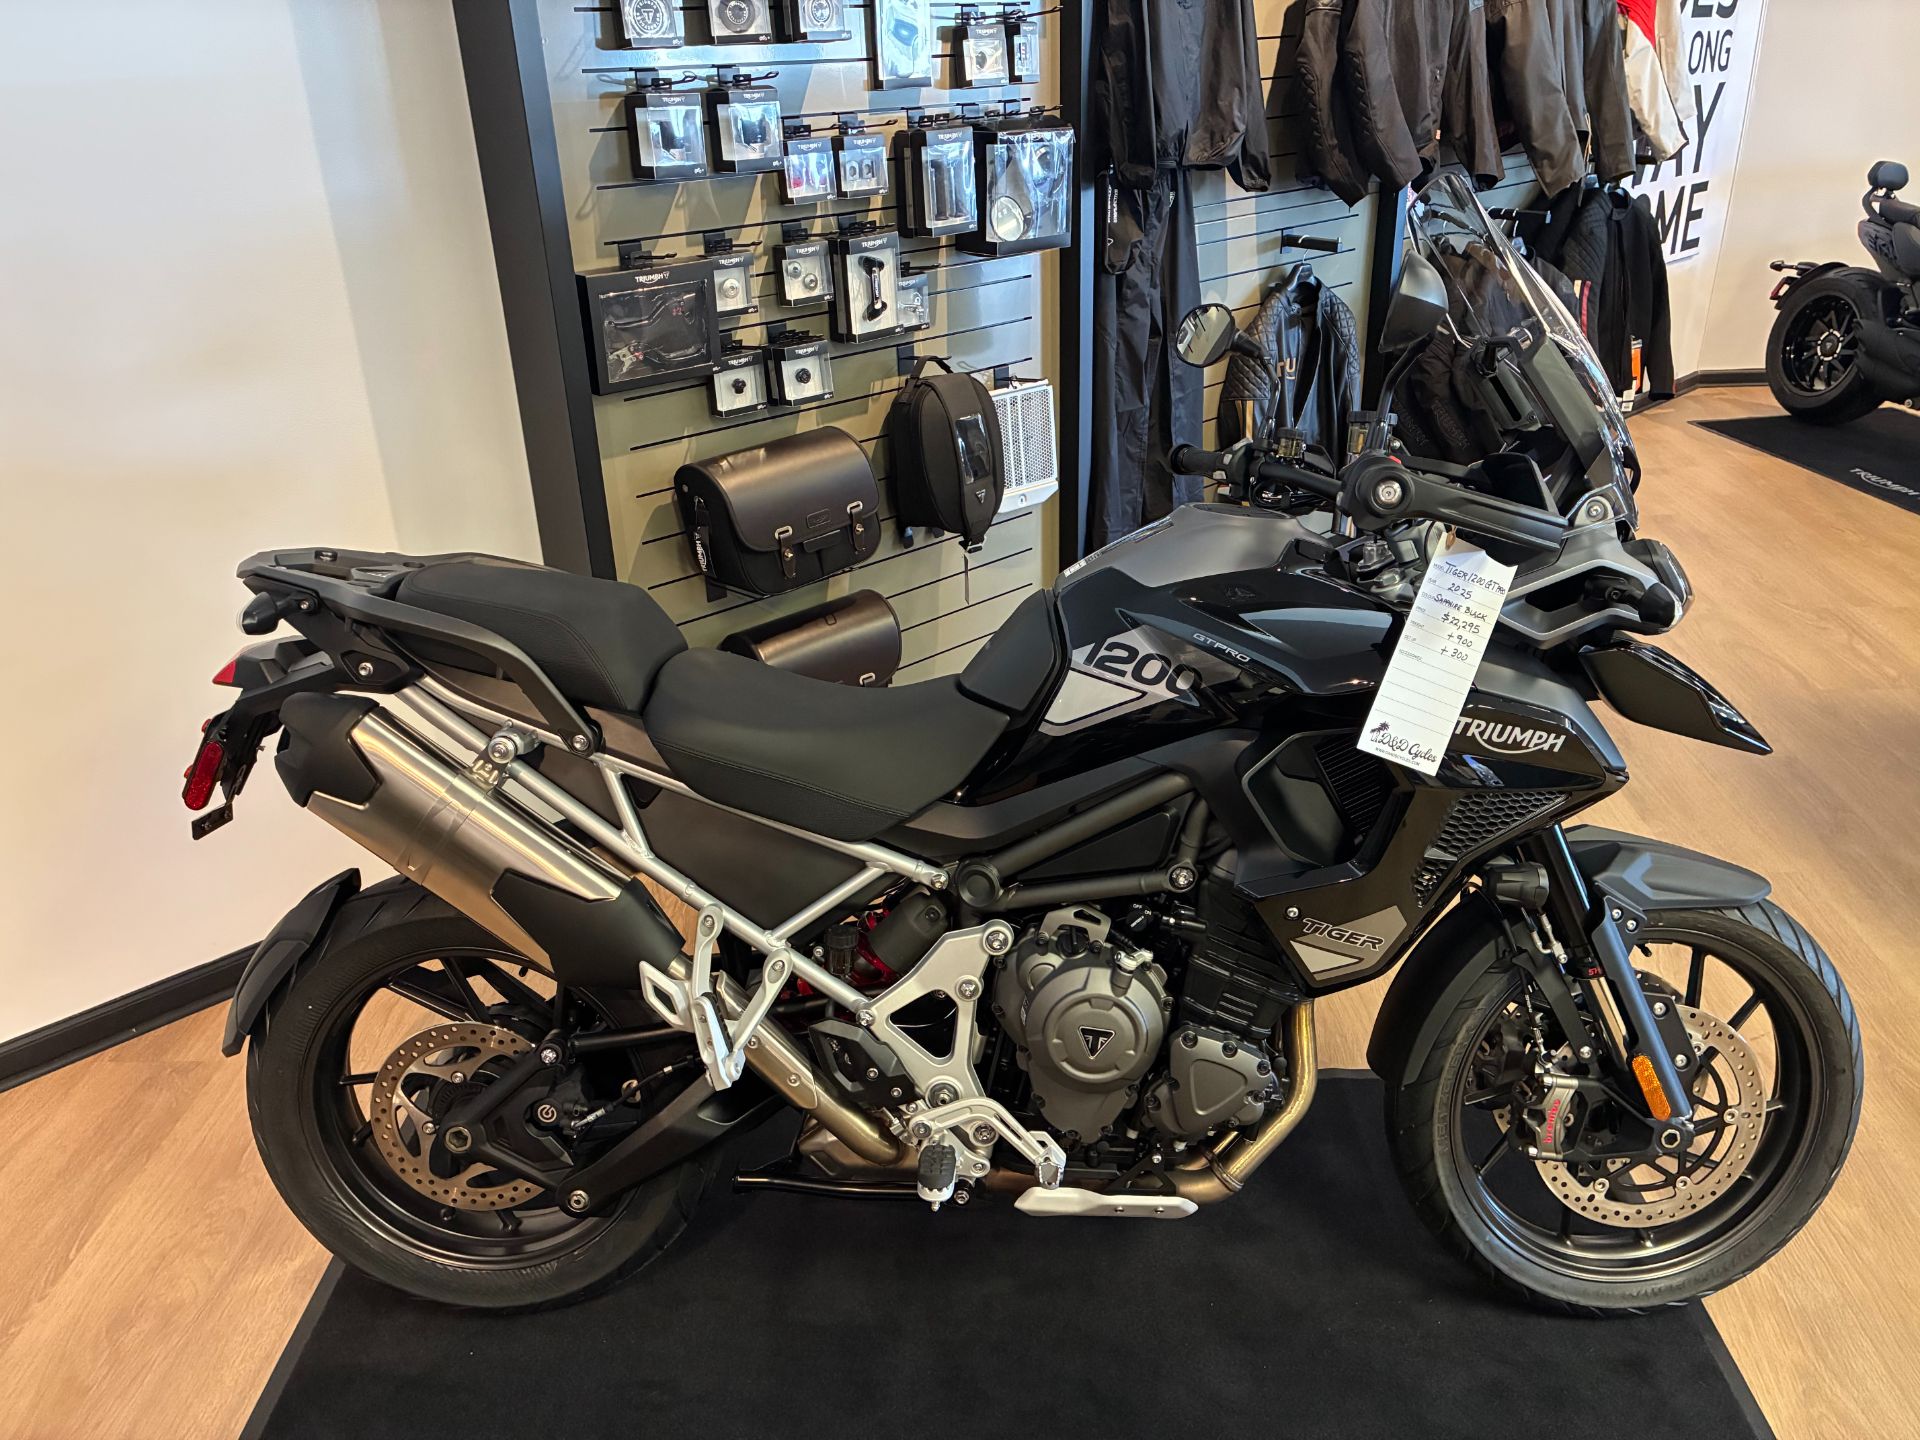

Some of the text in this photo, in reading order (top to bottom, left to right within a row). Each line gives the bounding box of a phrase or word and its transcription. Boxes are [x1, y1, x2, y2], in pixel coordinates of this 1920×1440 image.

[1688, 29, 1733, 75] ONG
[1655, 180, 1709, 255] ME
[861, 238, 883, 248] TRIUMPH
[635, 273, 663, 284] TRIUMPH
[695, 540, 707, 572] TRIUMPH
[1445, 561, 1468, 581] TIGER
[1441, 612, 1480, 634] $22,295
[1451, 648, 1469, 661] 300
[1457, 635, 1473, 648] 900
[1083, 638, 1202, 697] 1200
[1378, 732, 1437, 762] D&D Cycles
[1455, 716, 1567, 754] TRIUMPH
[1302, 917, 1385, 952] TIGER
[1543, 1098, 1561, 1144] brembo
